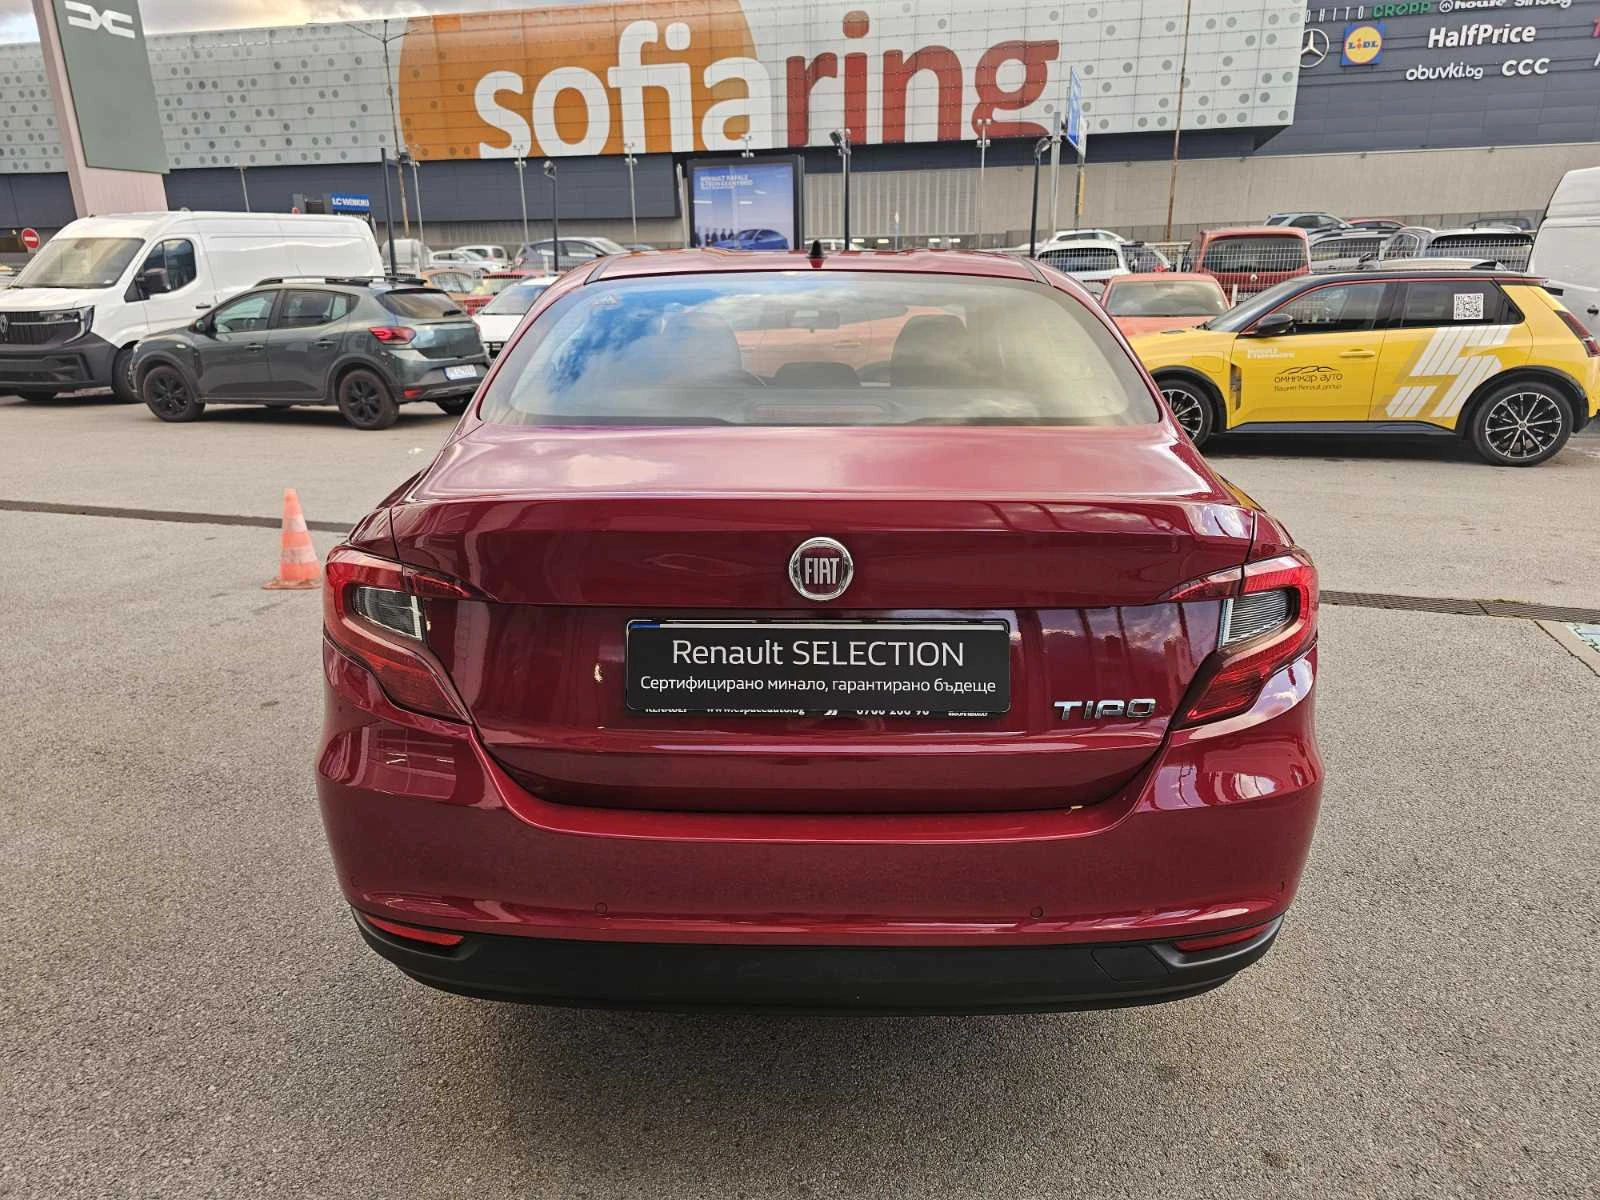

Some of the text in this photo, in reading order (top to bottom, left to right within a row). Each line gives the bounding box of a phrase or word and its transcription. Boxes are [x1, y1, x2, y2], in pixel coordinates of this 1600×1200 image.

[1373, 1, 1431, 18] CROPP
[1427, 23, 1537, 49] HalfPrice
[1405, 61, 1484, 81] obuvki.bg
[1501, 57, 1550, 77] CCC
[804, 557, 840, 585] FIAT
[672, 639, 964, 667] Renault SELECTION
[640, 675, 997, 694] Сертифицирано минало, гарантирано бъдеще
[1053, 698, 1157, 721] TIPO
